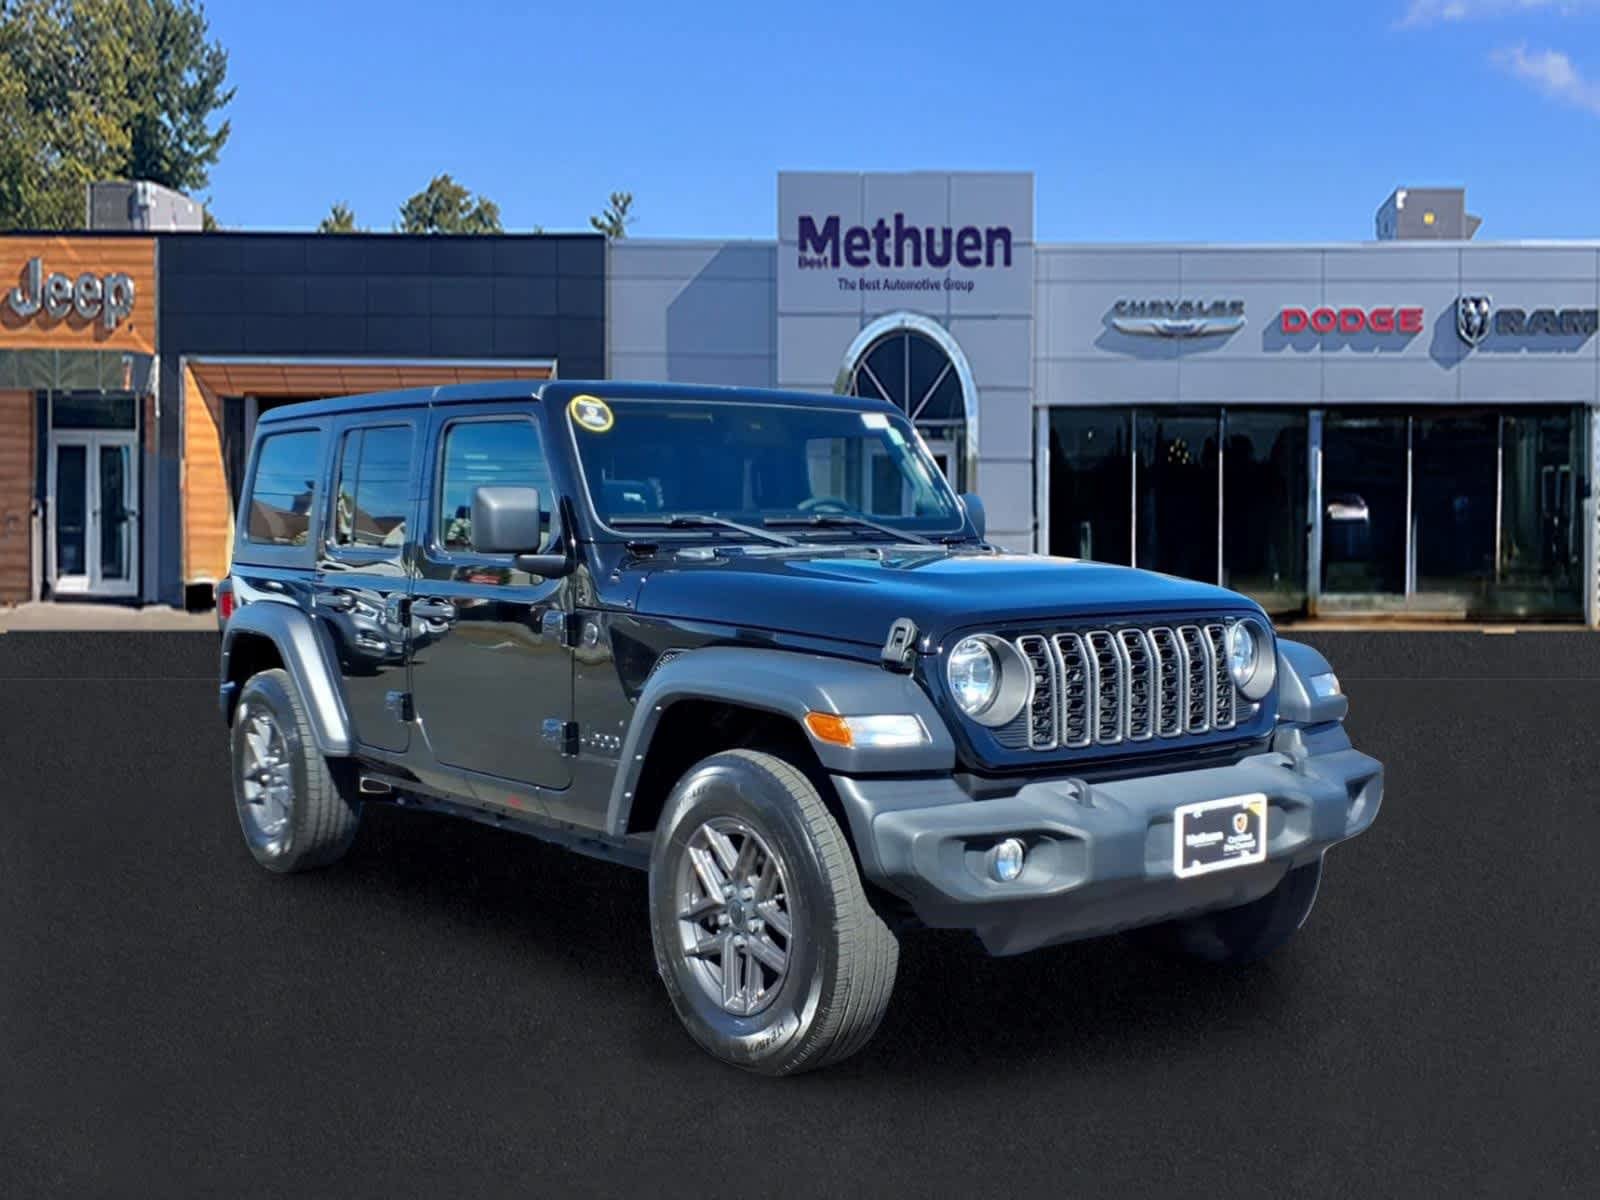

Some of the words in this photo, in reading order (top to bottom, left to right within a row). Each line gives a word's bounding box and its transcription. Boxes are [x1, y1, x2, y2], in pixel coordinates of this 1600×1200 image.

[798, 213, 1012, 268] Methuen
[9, 257, 134, 328] Jeep
[838, 277, 856, 290] The
[859, 277, 881, 290] Best
[883, 277, 941, 290] Automotive
[943, 277, 975, 293] Group
[1281, 308, 1424, 333] DODGE
[1495, 309, 1599, 335] RAM
